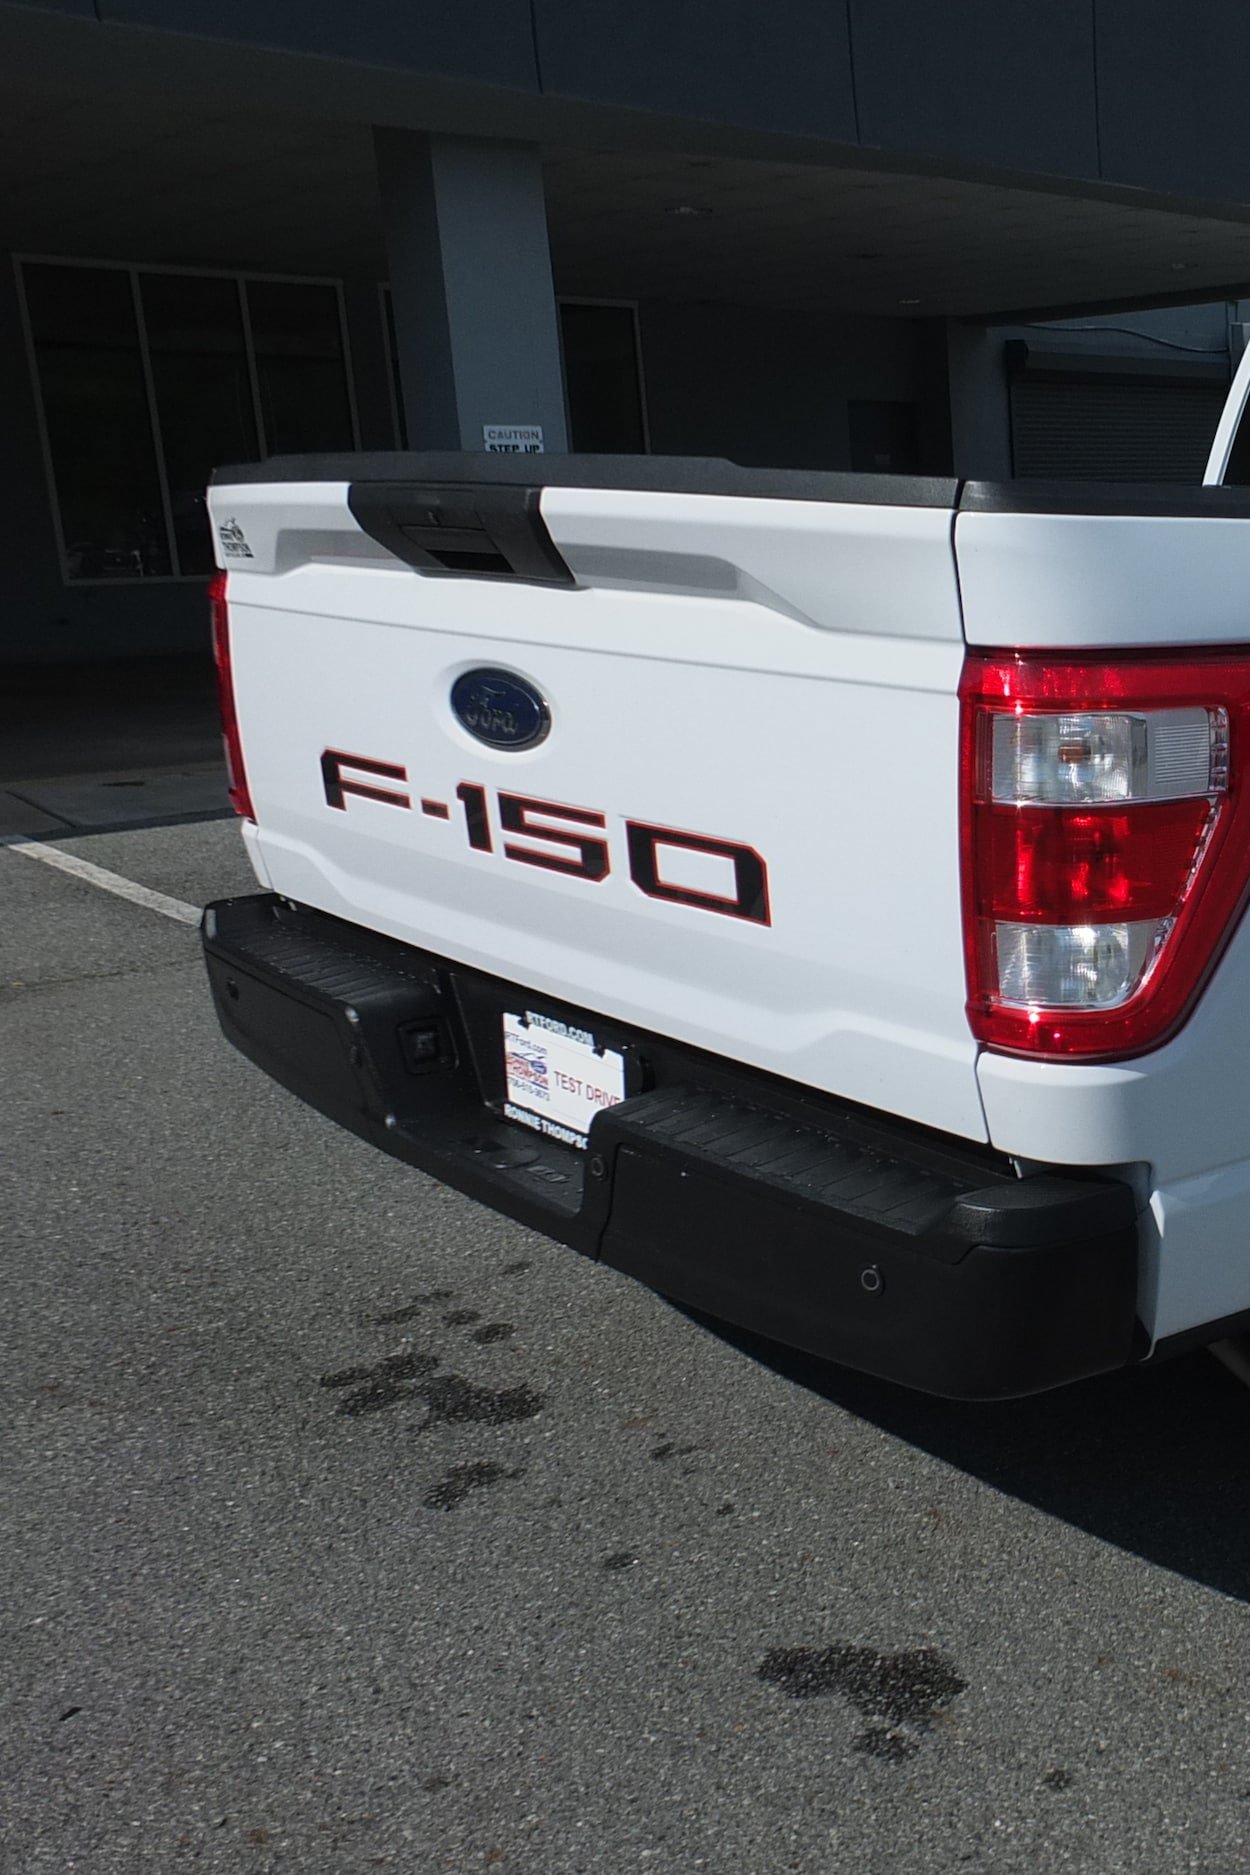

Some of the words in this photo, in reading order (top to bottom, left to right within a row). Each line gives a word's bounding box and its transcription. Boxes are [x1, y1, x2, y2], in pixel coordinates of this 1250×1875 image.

[487, 430, 540, 440] CAUTION
[489, 443, 520, 453] STEP
[525, 443, 541, 454] UP
[465, 685, 518, 735] Ford
[319, 746, 772, 927] F-150
[553, 1070, 583, 1096] TEST
[504, 1103, 541, 1131] RONNIE
[541, 1119, 588, 1150] THOMPSO
